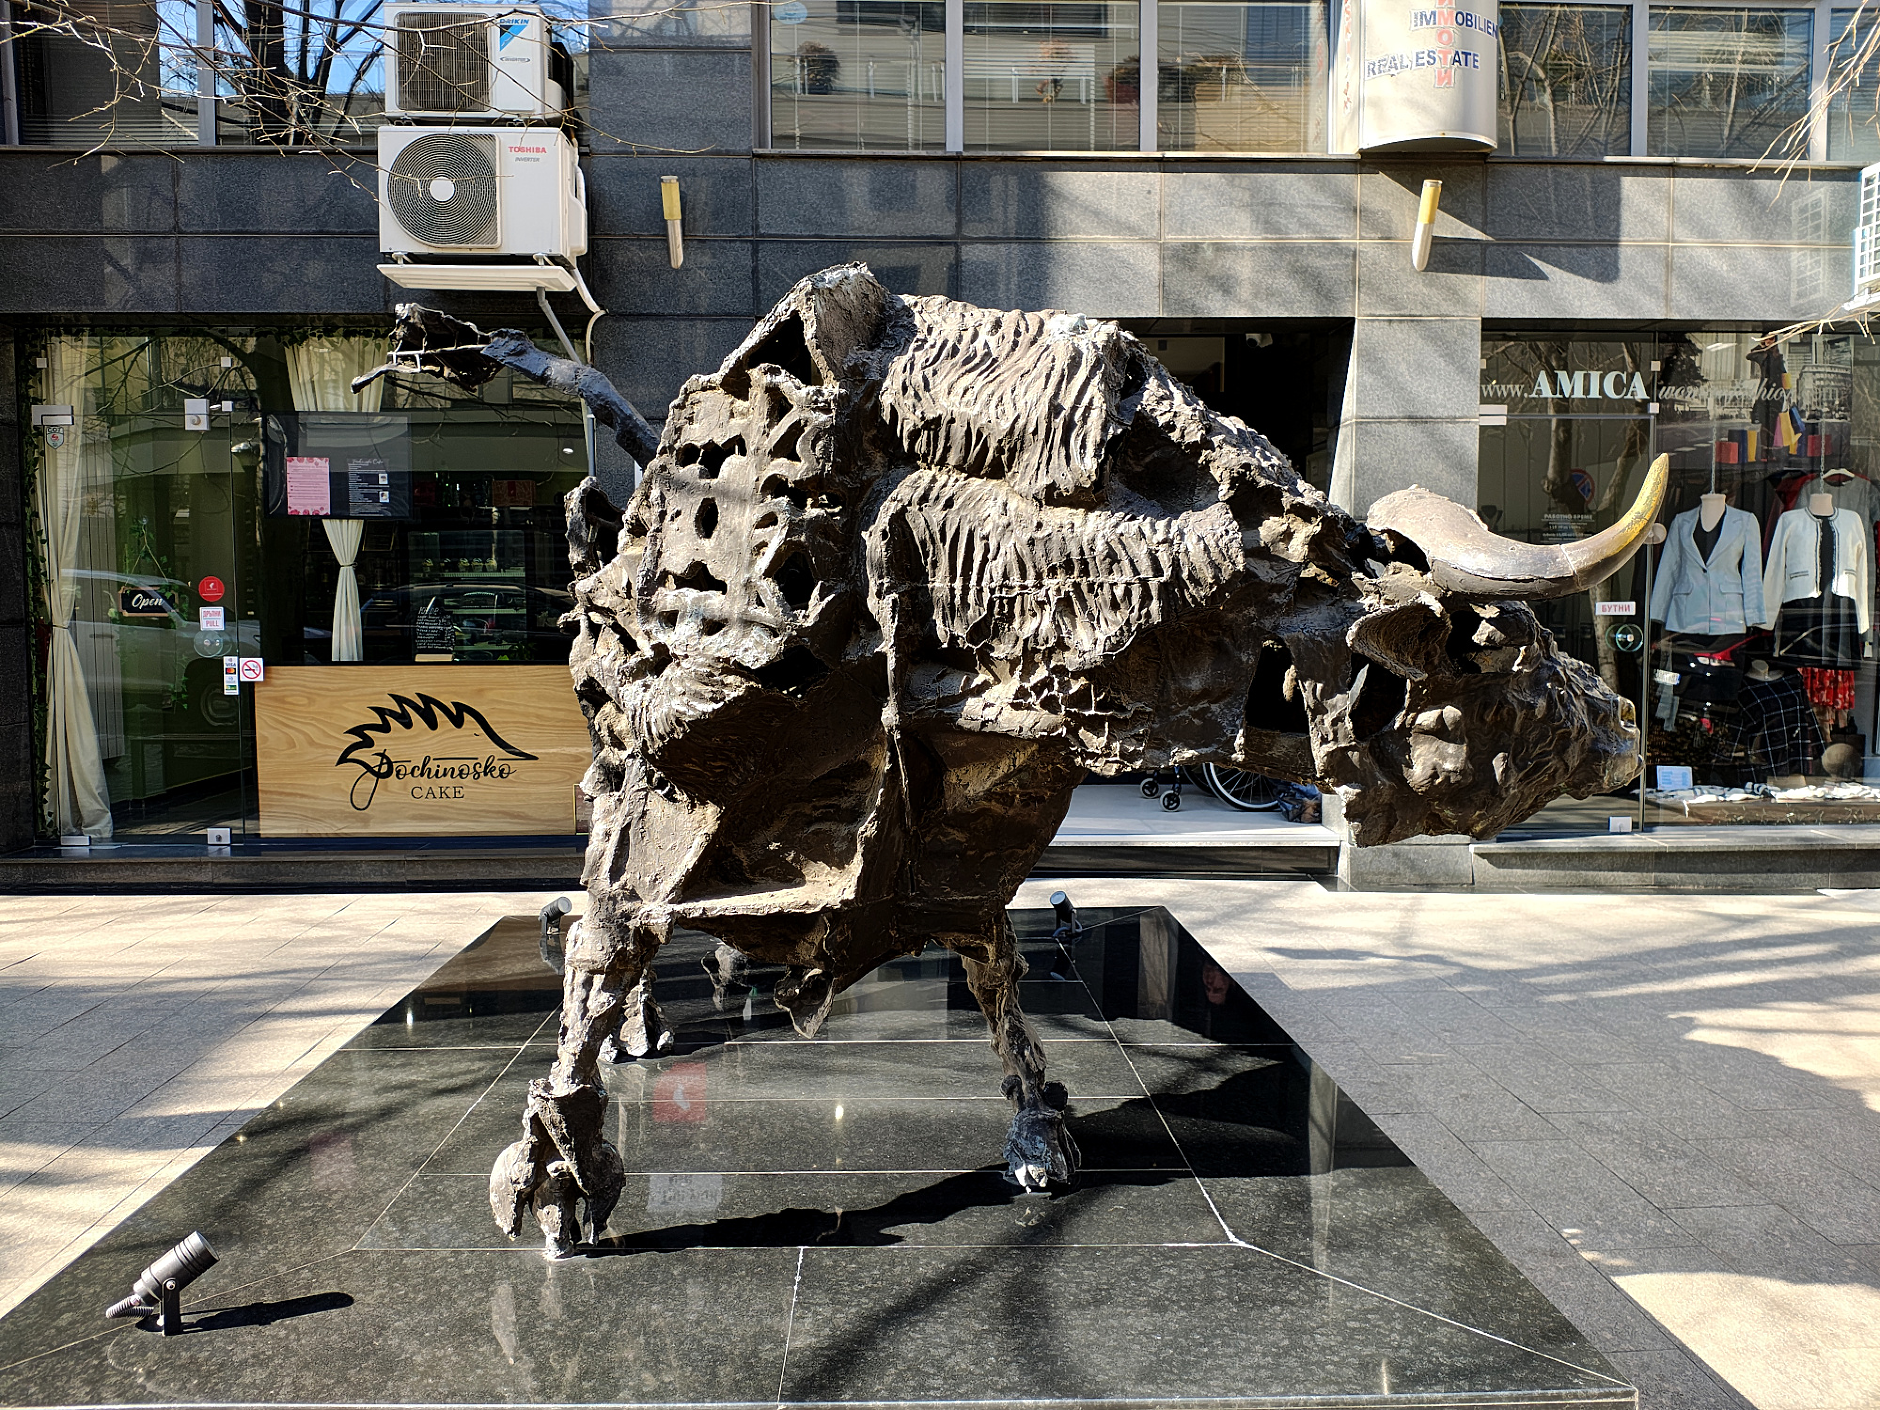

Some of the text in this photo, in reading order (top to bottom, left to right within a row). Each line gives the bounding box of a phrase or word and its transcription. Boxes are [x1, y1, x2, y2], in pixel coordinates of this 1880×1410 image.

[1366, 49, 1480, 78] REAL ESTATE
[131, 593, 163, 610] Open
[1601, 604, 1631, 613] БУТНИ
[410, 786, 465, 799] CAKE
